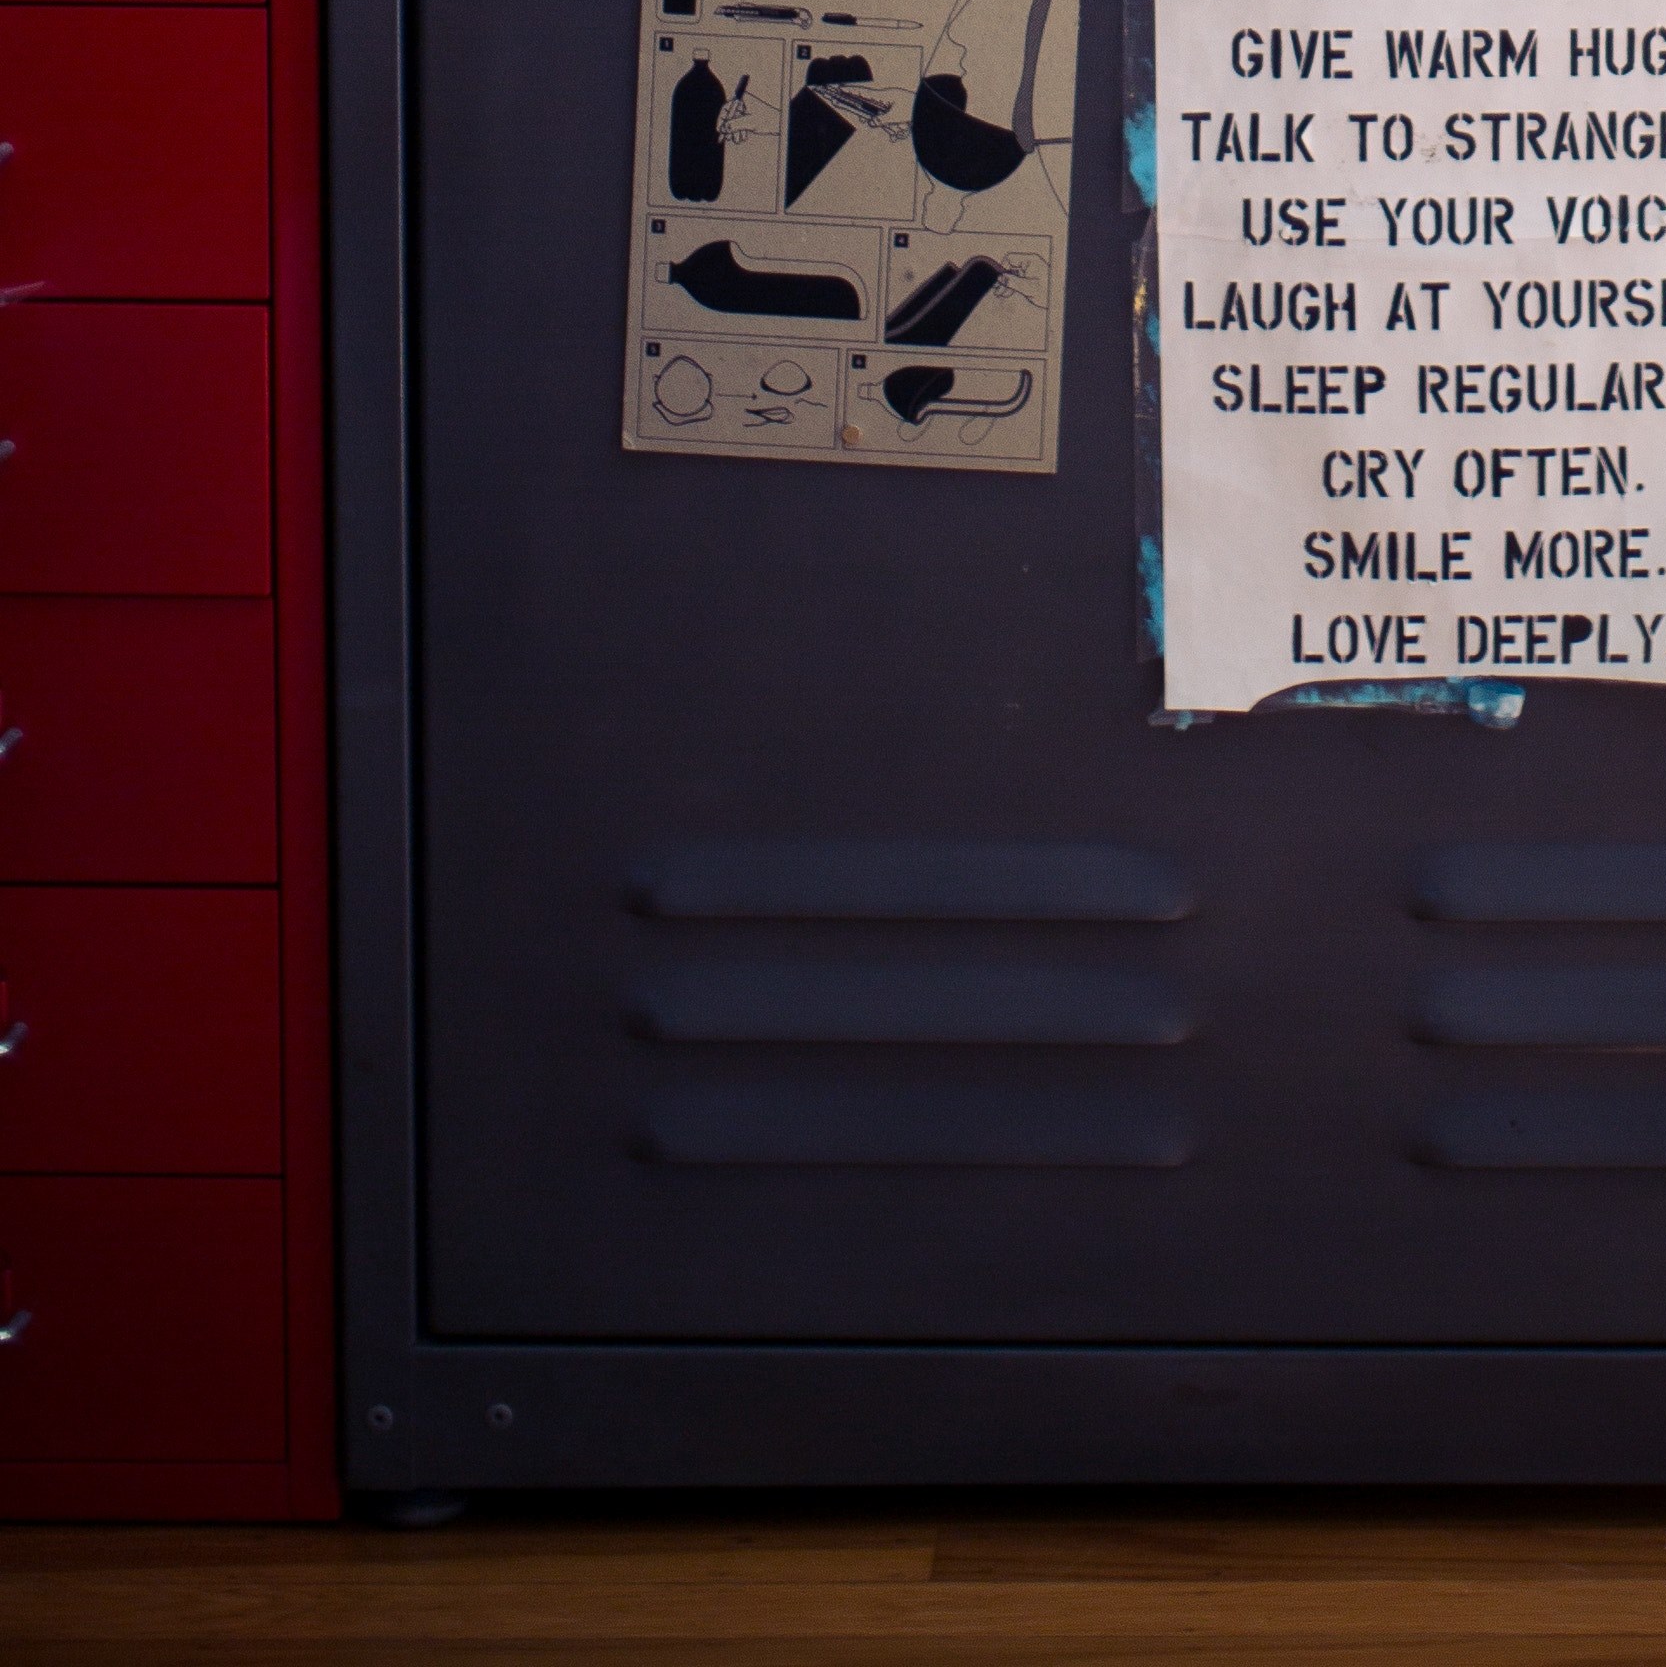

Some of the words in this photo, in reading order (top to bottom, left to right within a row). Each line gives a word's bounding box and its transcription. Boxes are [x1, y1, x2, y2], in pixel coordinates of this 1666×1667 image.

[1231, 28, 1353, 80] GIVE
[1385, 28, 1538, 79] WARM
[1181, 112, 1315, 163] TALK
[1348, 112, 1414, 161] TO
[1242, 198, 1346, 247] USE
[1378, 197, 1514, 246] YOUR
[1184, 281, 1356, 331] LAUGH
[1385, 282, 1450, 331] AT
[1212, 364, 1386, 415] SLEEP
[1321, 449, 1425, 498] CRY
[1453, 446, 1645, 498] OFTEN.
[1304, 531, 1472, 581] SMILE
[1504, 528, 1666, 580] MORE.
[1292, 614, 1427, 664] LOVE
